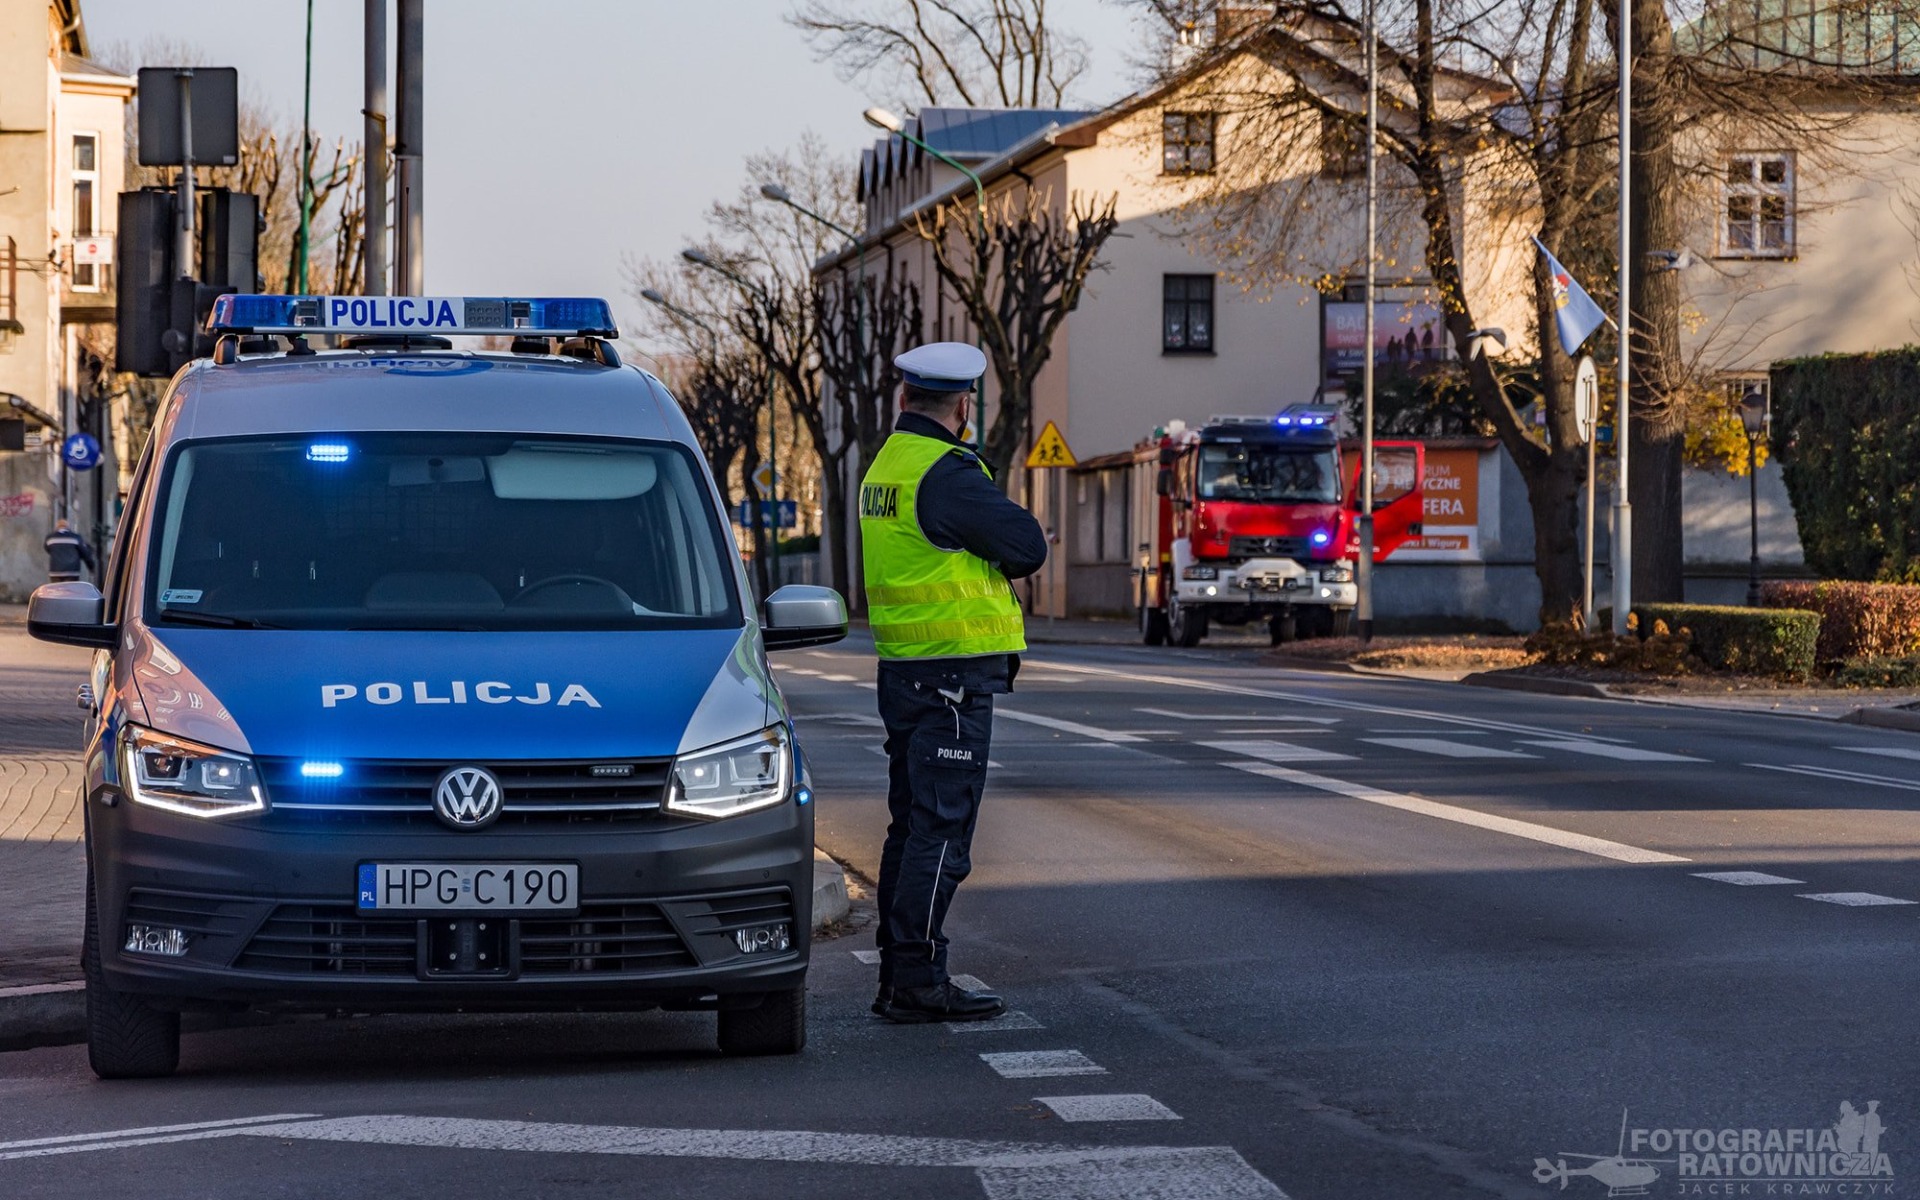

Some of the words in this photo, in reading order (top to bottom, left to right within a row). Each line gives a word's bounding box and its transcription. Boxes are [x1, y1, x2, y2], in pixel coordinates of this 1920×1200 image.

[332, 299, 457, 327] POLICJA
[1395, 464, 1451, 477] CENRUM
[1394, 477, 1462, 491] MEYCZNE
[861, 486, 897, 518] OLICJA
[1422, 498, 1465, 516] FERA
[321, 681, 602, 708] POLICJA
[937, 747, 972, 760] POLICJA
[361, 891, 374, 901] PL
[385, 869, 458, 905] HPG
[474, 869, 568, 905] C190
